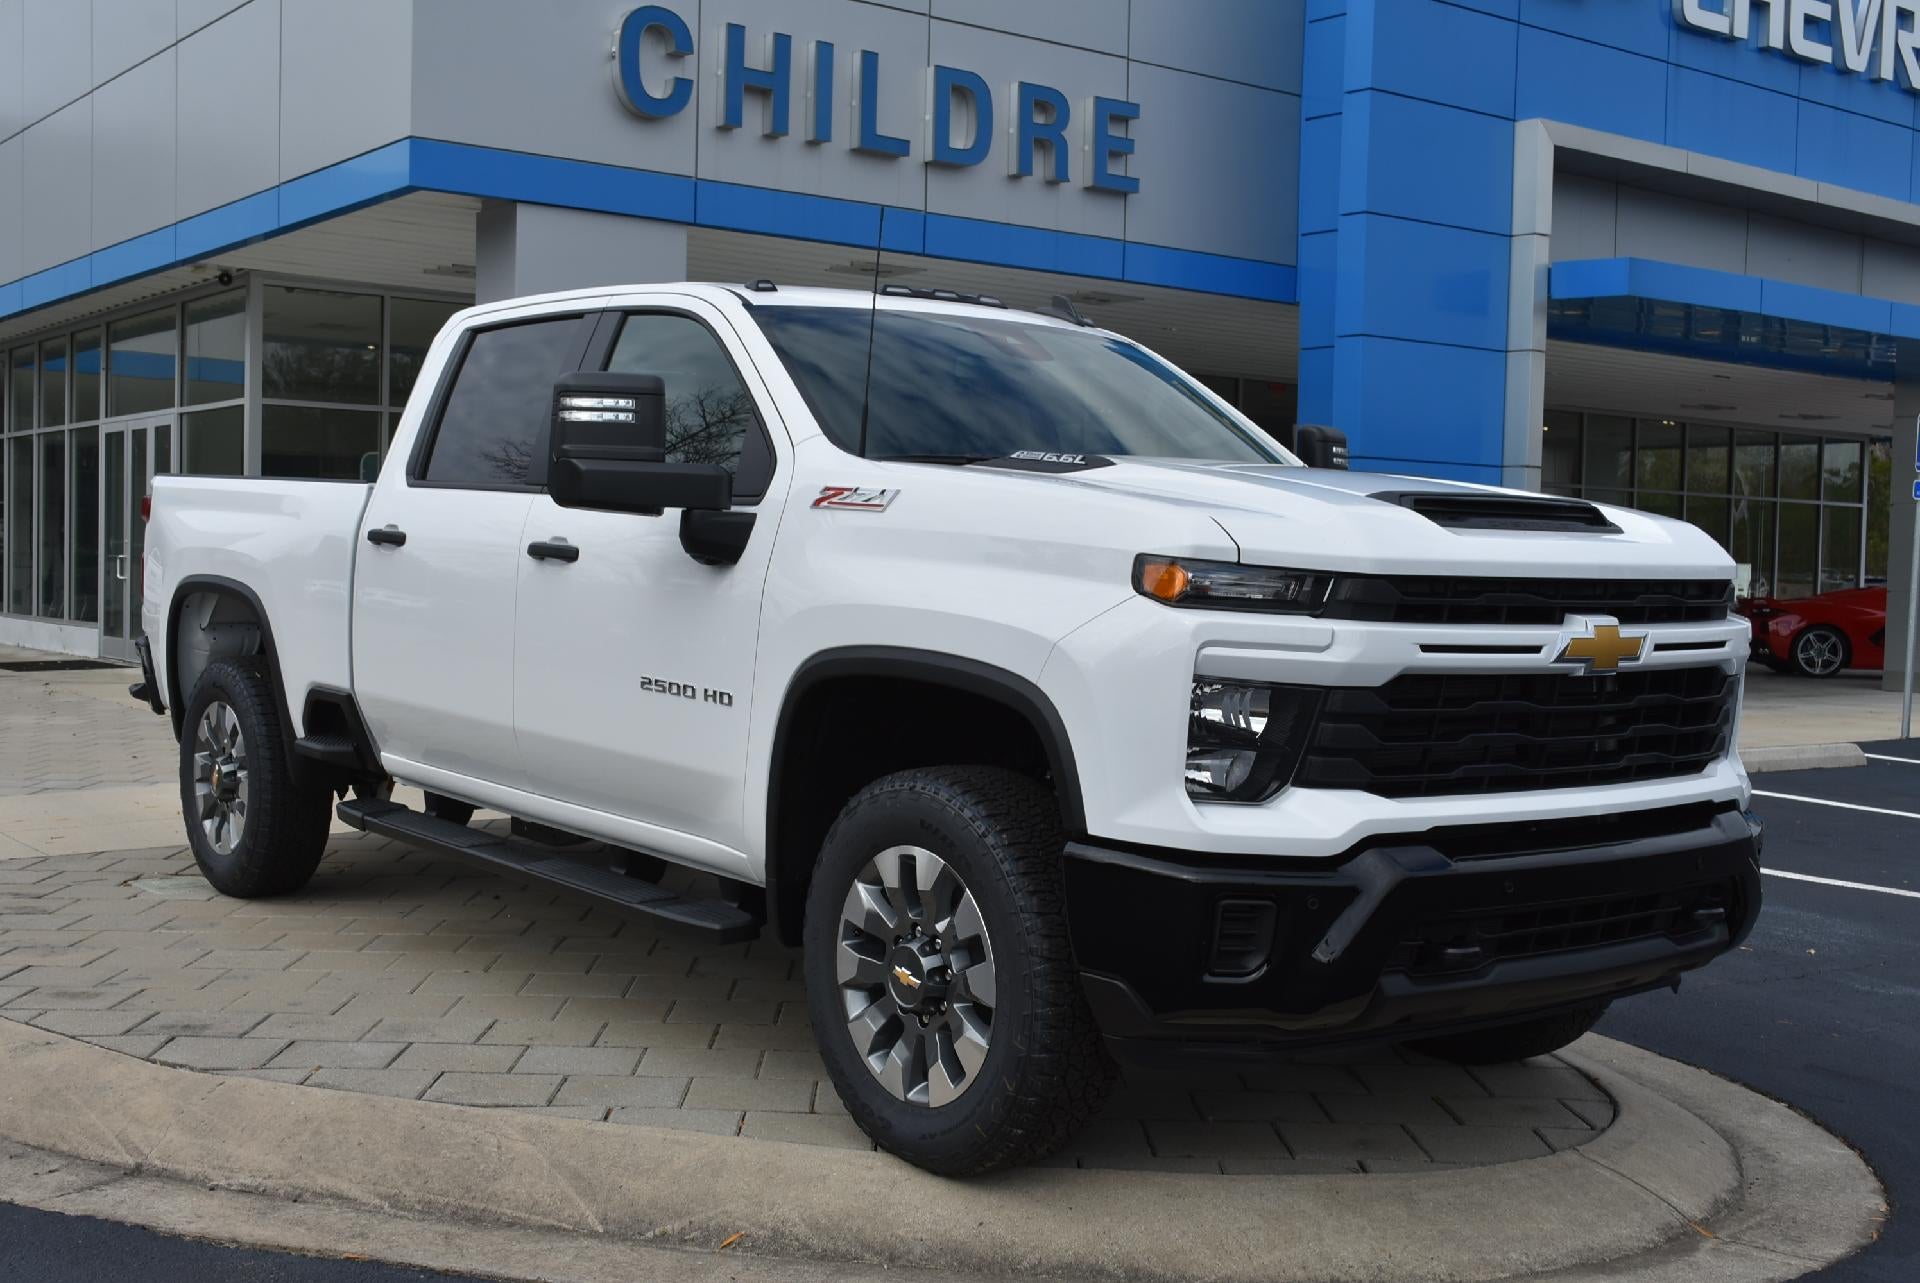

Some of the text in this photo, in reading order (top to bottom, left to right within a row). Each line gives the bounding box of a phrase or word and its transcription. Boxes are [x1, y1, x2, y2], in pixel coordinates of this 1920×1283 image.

[613, 5, 1140, 193] CHILDRE
[810, 486, 901, 513] Z71
[640, 676, 733, 708] 2500 HD
